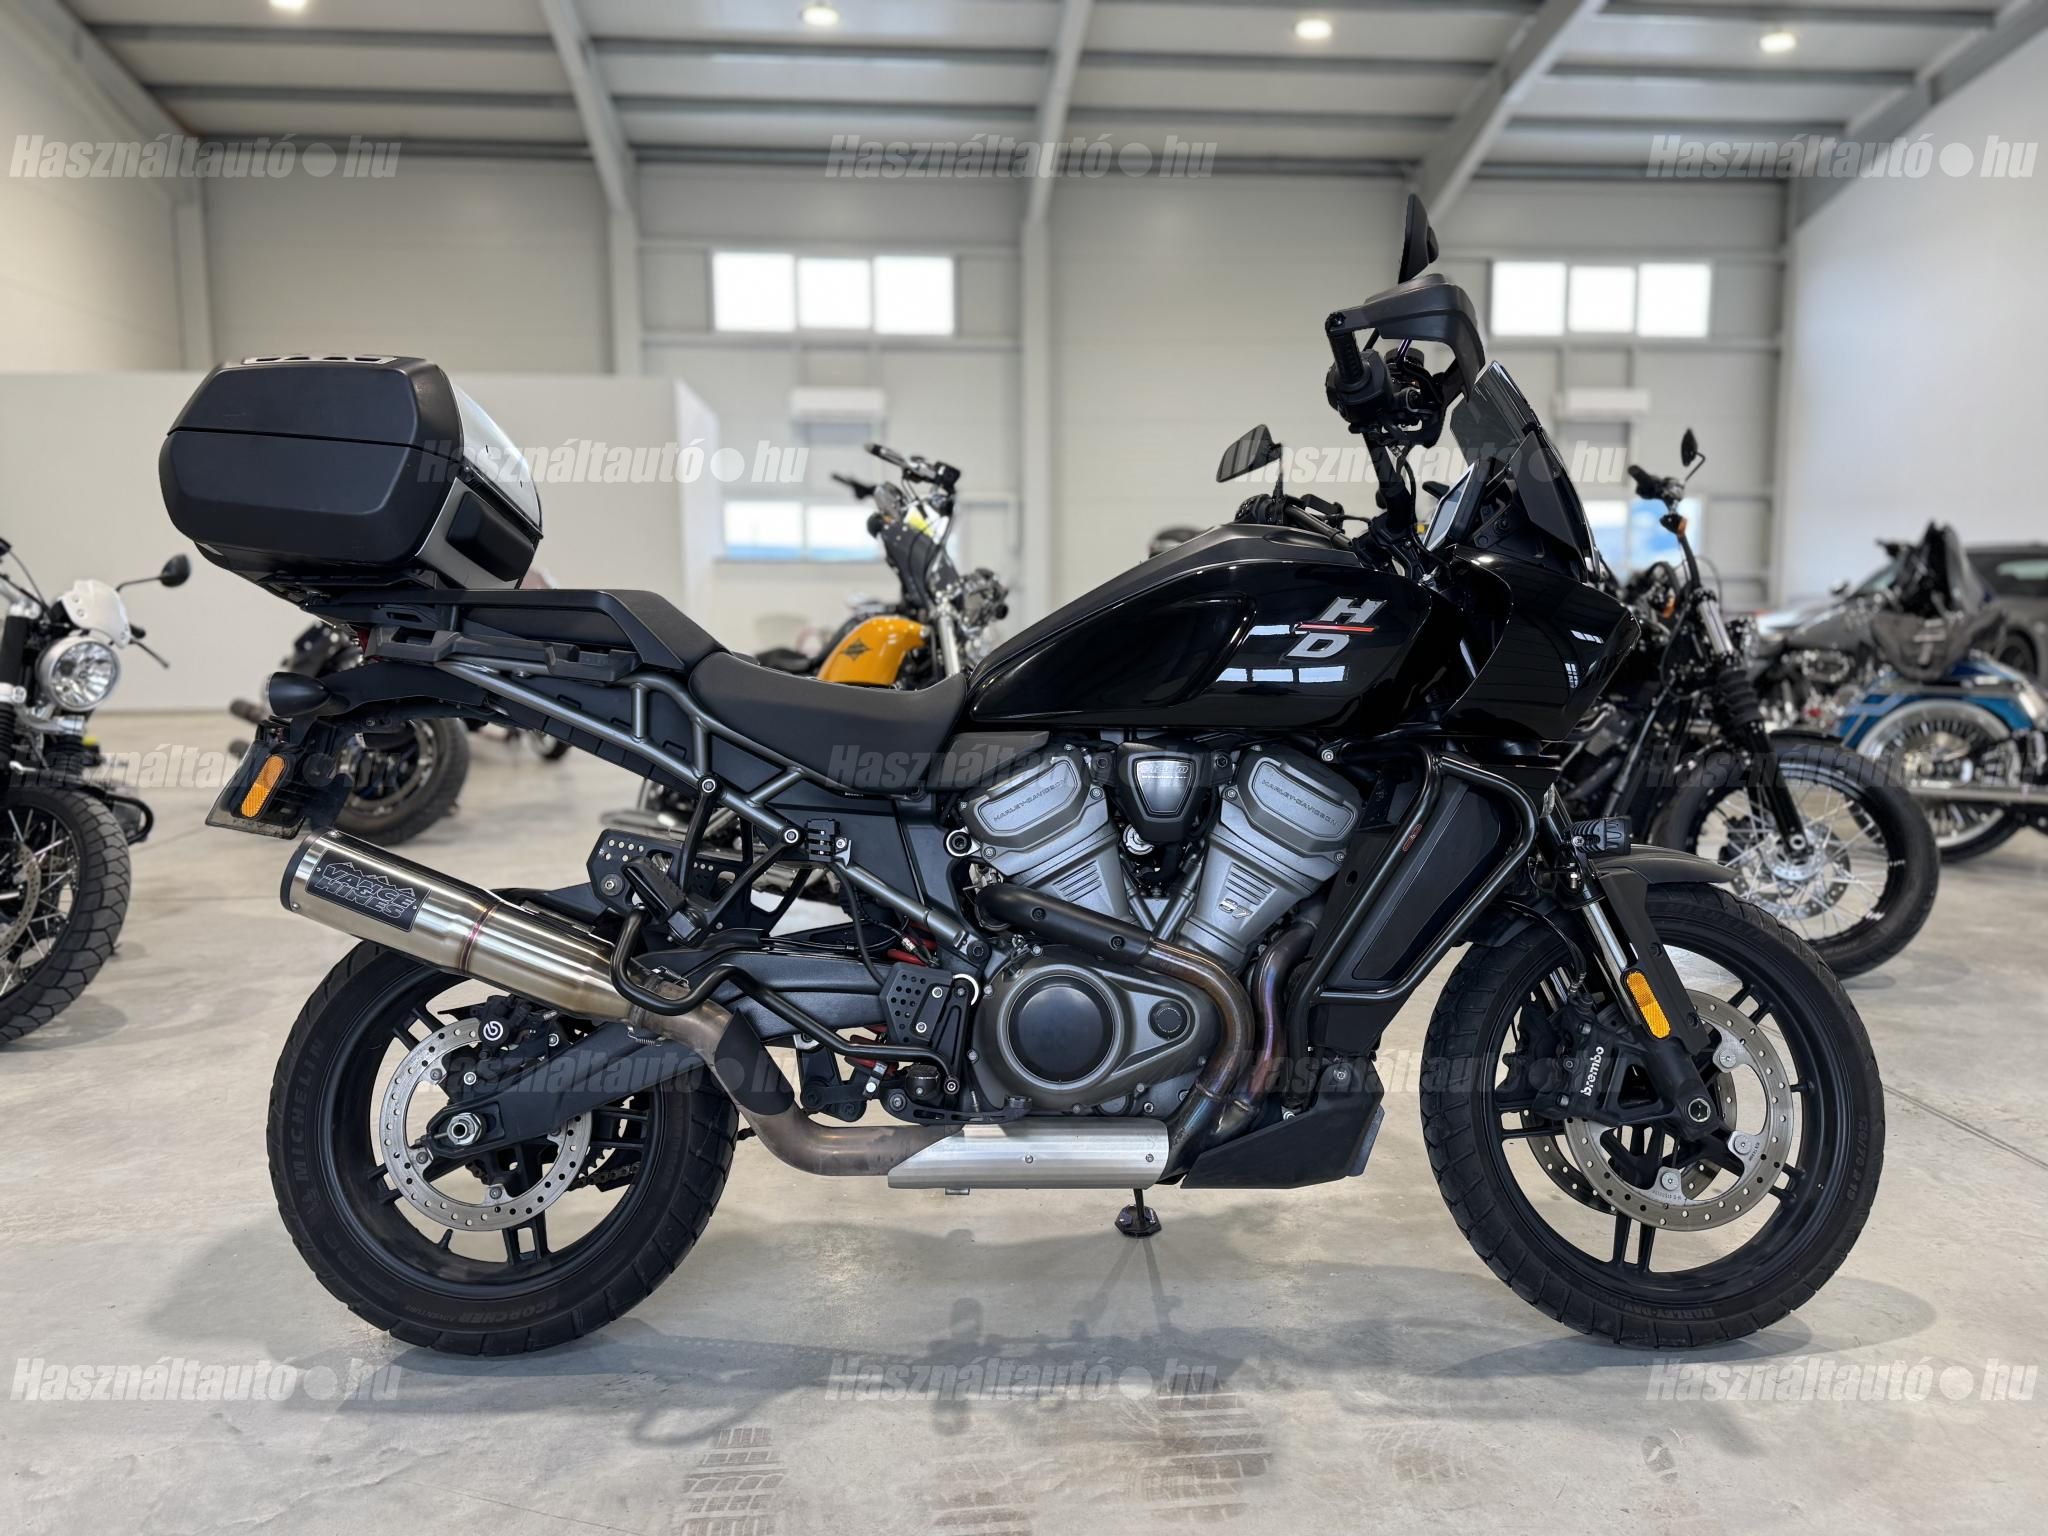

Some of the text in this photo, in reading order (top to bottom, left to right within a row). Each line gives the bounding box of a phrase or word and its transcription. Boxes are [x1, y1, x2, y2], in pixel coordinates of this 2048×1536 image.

[314, 875, 407, 920] HINES
[322, 865, 417, 908] VANCE
[1580, 1046, 1605, 1097] brembo
[288, 1037, 326, 1183] MICHELIN
[458, 1294, 560, 1325] SCORCHER
